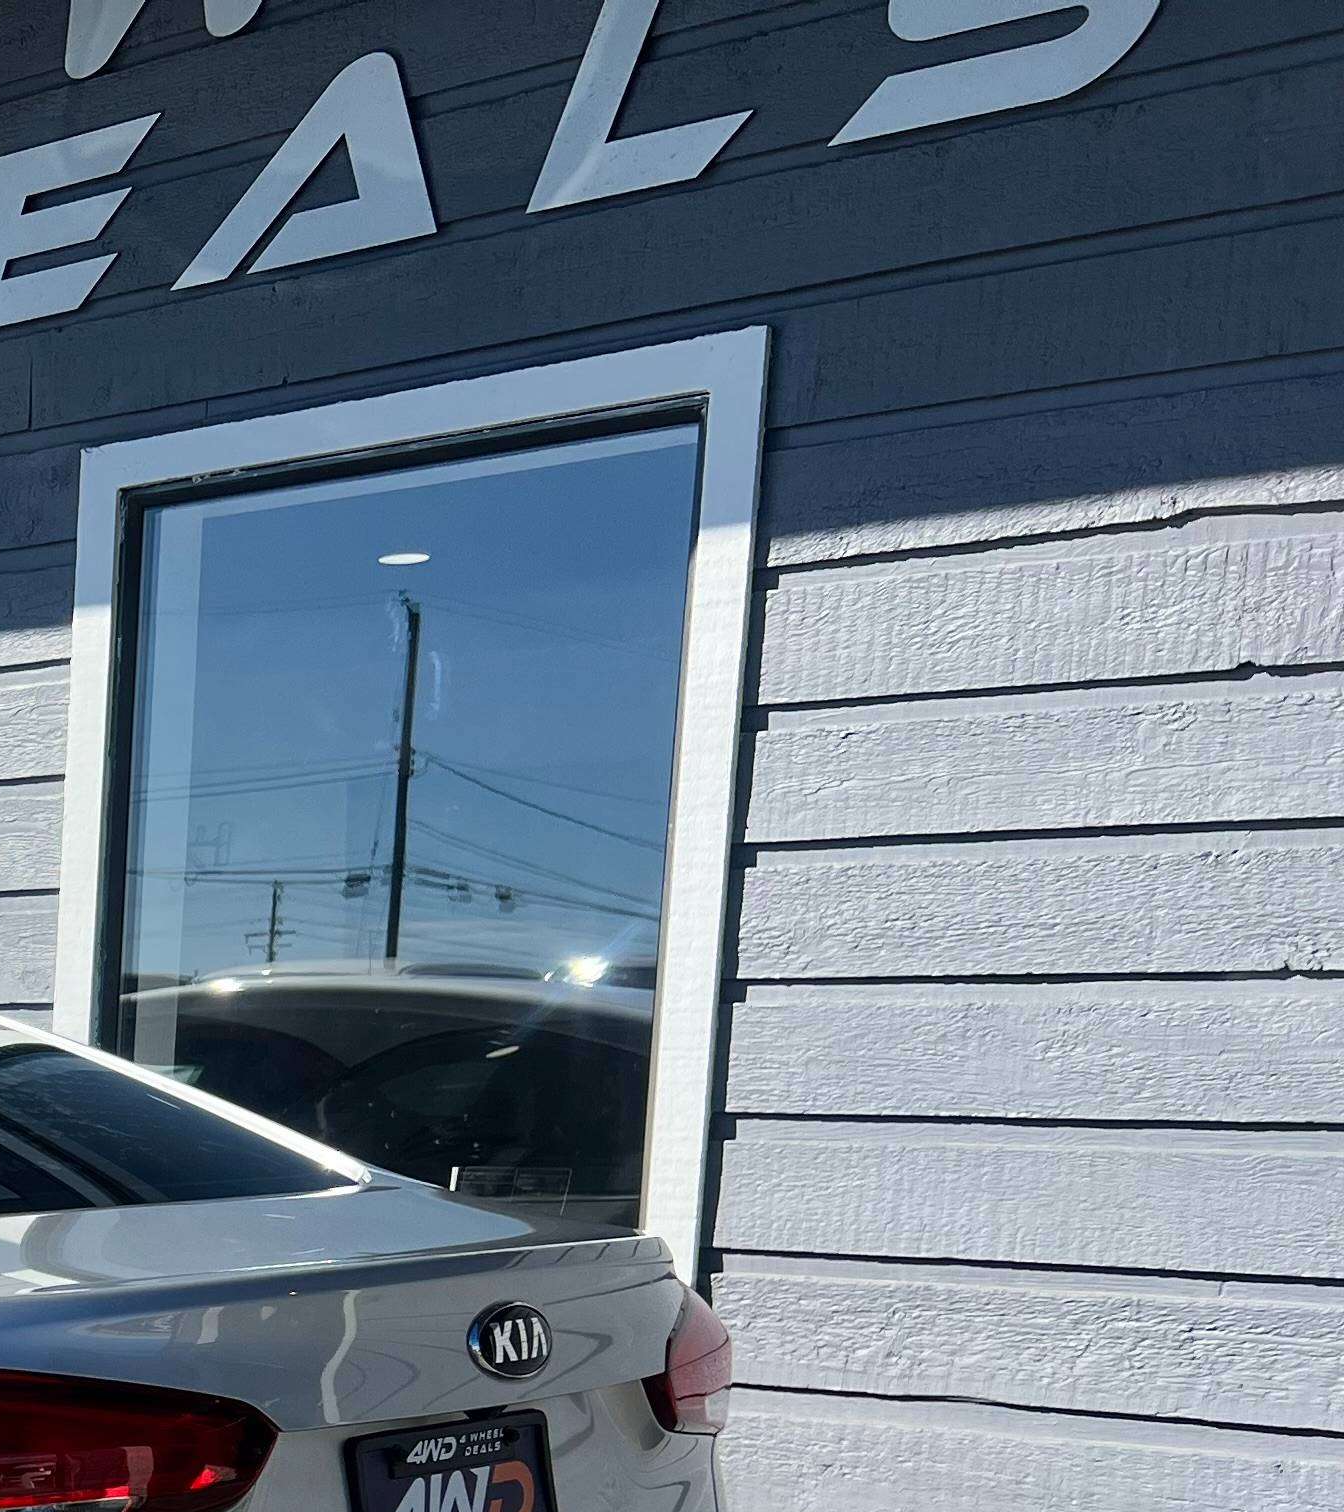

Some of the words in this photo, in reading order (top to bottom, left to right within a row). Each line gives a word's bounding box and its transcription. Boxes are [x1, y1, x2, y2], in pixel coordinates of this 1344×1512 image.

[490, 1317, 548, 1364] KIA
[470, 1427, 505, 1443] WHEEL
[406, 1436, 458, 1465] 4WD
[464, 1440, 502, 1457] DEALS
